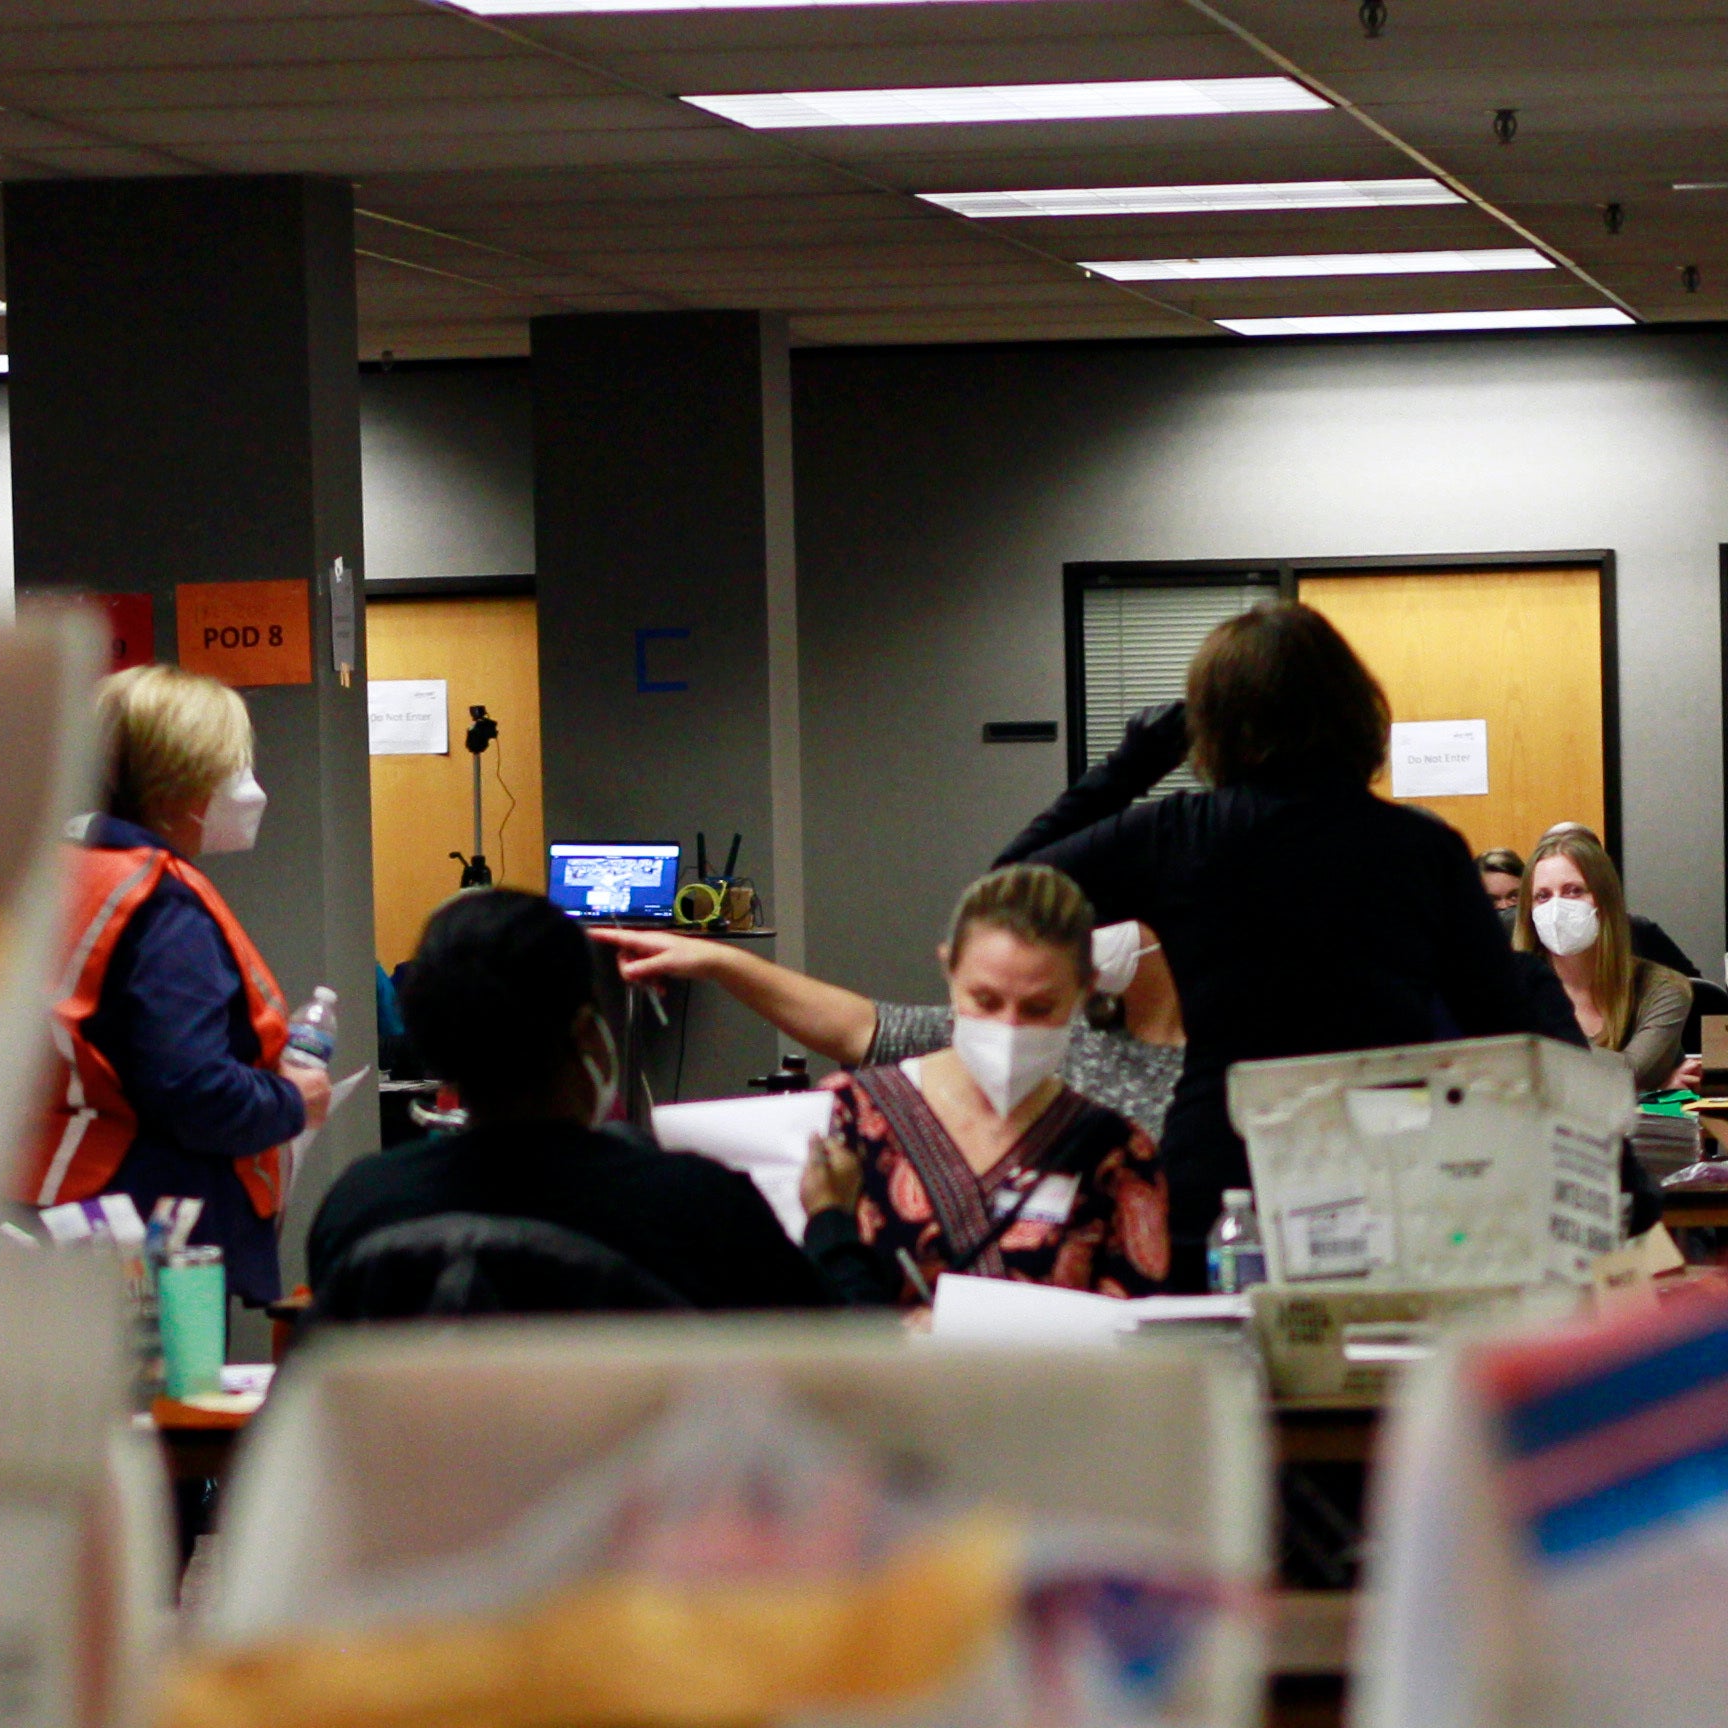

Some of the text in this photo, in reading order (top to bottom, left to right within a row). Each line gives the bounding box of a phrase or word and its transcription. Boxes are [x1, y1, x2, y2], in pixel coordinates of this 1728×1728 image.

[203, 624, 284, 650] POD 8
[385, 713, 403, 722] Not
[406, 712, 431, 722] Enter
[1407, 753, 1471, 764] Do Not Enter
